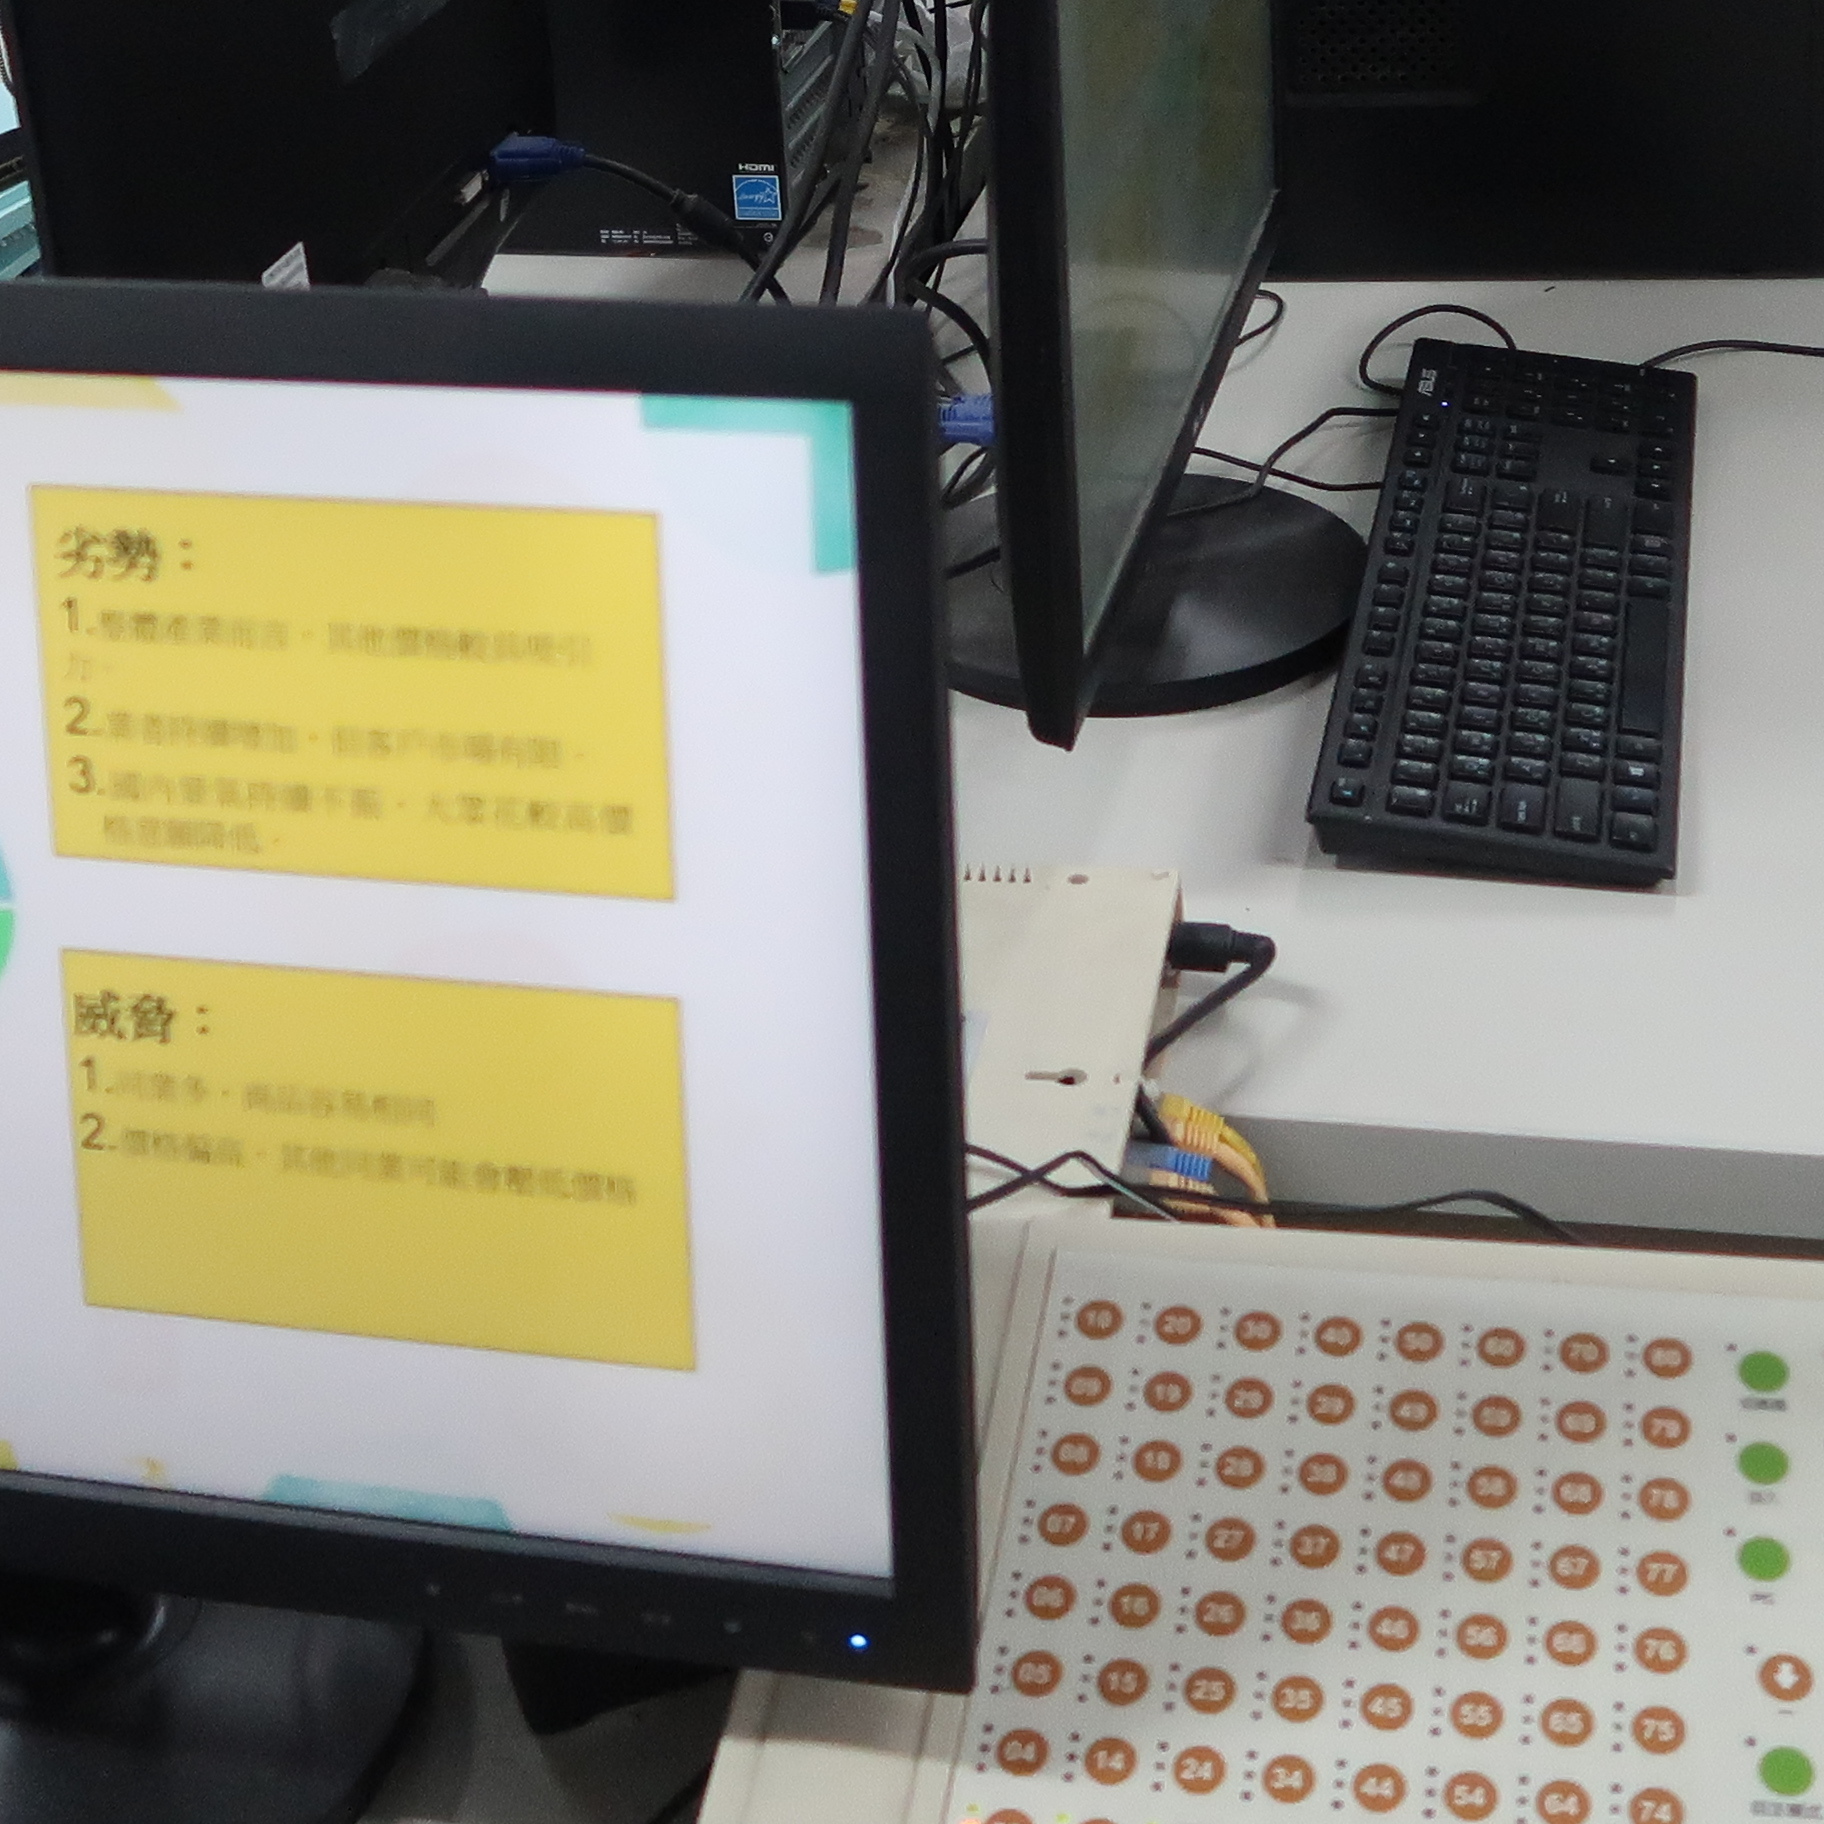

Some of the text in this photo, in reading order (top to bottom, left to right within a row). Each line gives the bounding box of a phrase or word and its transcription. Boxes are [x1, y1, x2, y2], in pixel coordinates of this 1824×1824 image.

[737, 162, 776, 173] HDMI
[56, 524, 193, 582] 劣勢：
[1645, 1561, 1680, 1584] 77
[1179, 1756, 1215, 1781] 24
